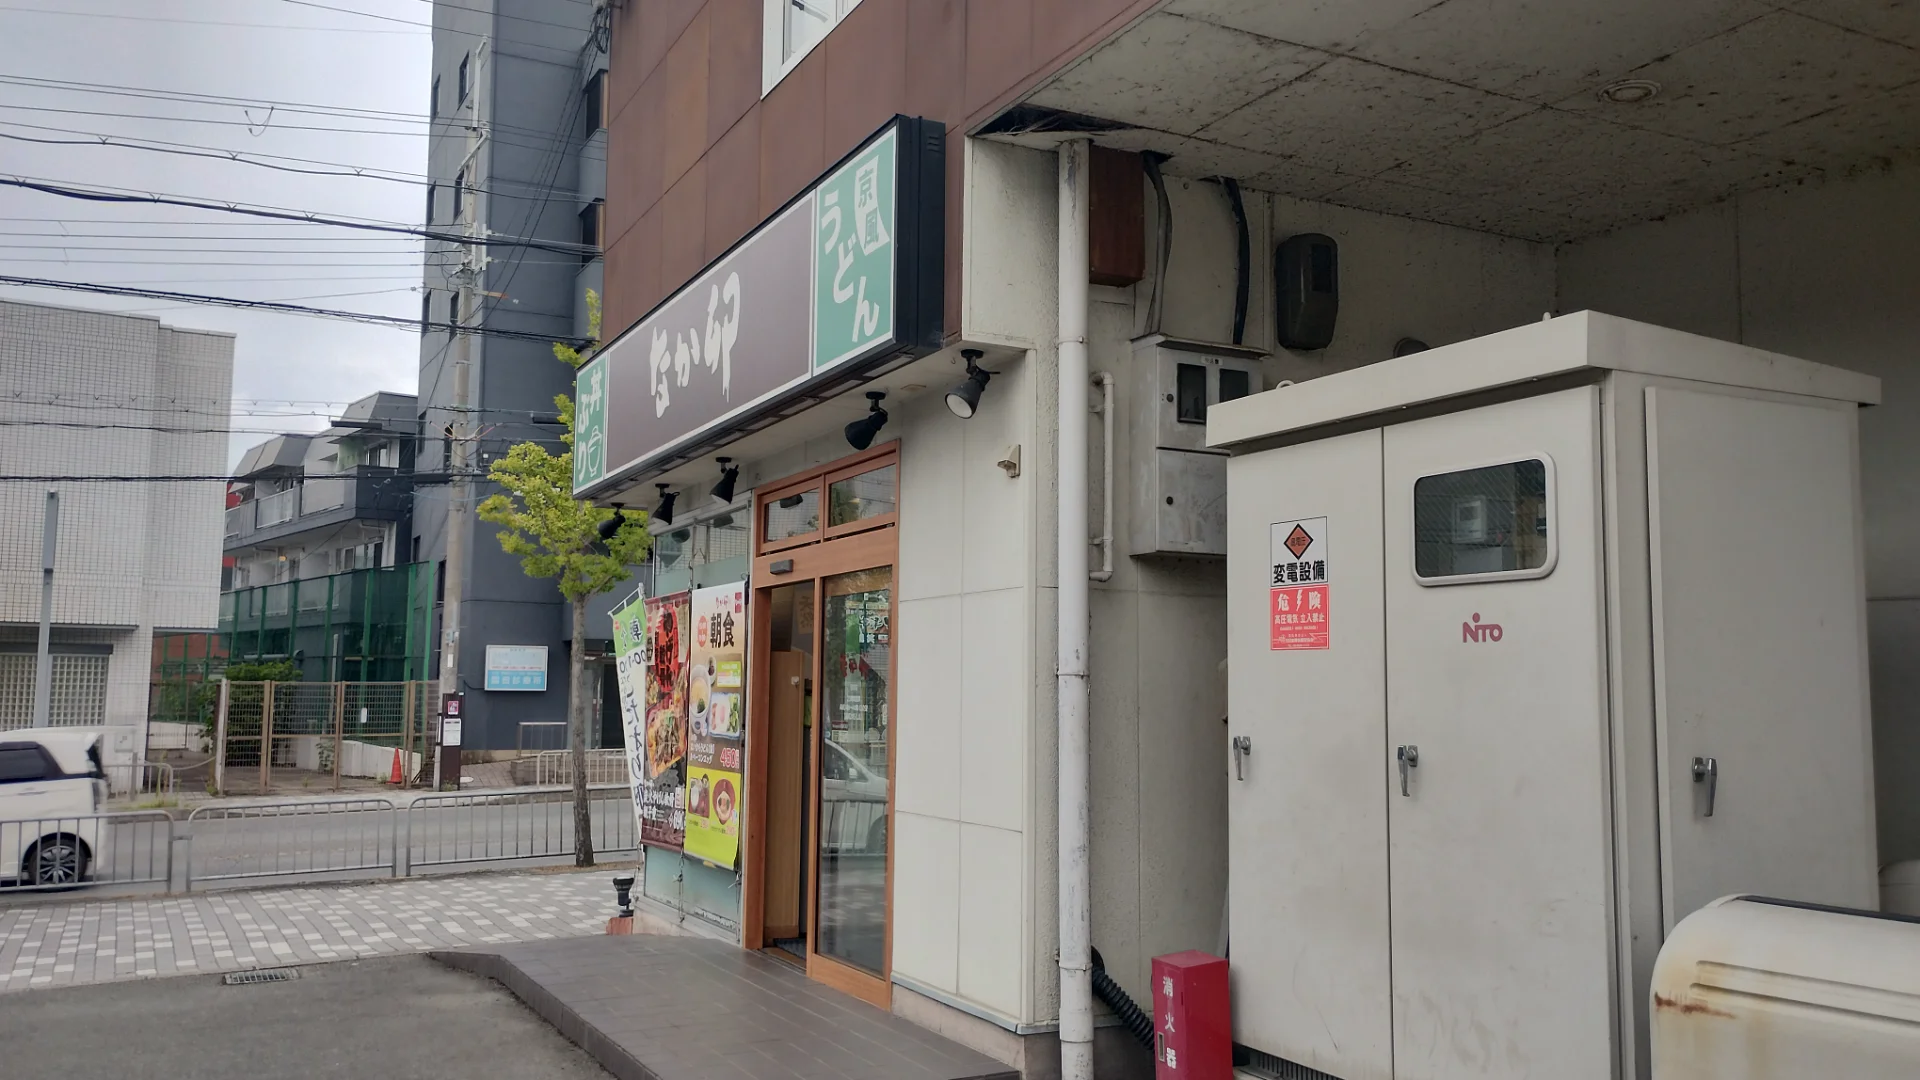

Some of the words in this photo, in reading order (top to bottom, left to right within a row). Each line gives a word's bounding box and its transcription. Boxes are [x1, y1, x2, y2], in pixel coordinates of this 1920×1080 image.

[820, 188, 880, 343] うどん
[649, 271, 741, 419] なか卯
[1273, 560, 1325, 584] 変電設備
[710, 610, 735, 649] 朝食
[1162, 975, 1177, 1070] 消火器
